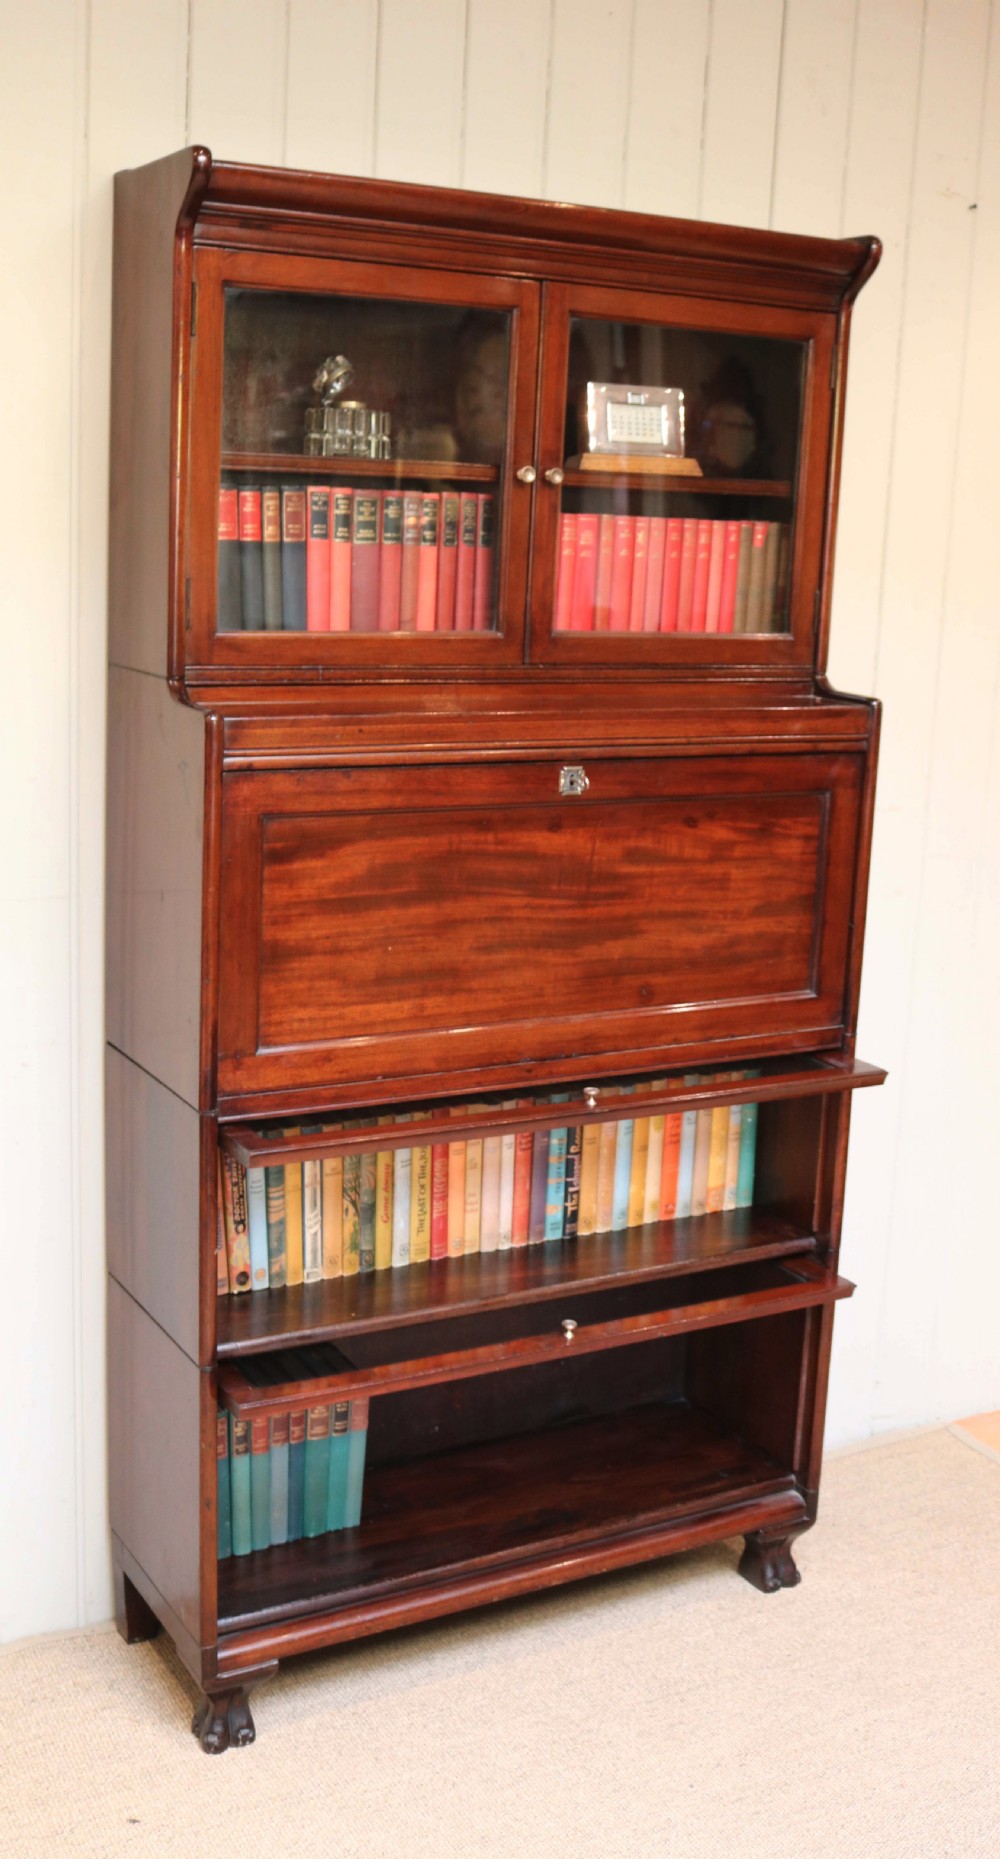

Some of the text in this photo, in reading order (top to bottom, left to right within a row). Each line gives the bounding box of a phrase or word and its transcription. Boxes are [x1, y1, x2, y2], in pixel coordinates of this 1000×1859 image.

[417, 1164, 427, 1183] THE
[418, 1182, 426, 1195] OF
[232, 1186, 241, 1221] DOCTOR
[381, 1195, 390, 1224] Gone
[417, 1195, 427, 1217] LAST
[564, 1193, 578, 1218] The
[416, 1218, 425, 1236] THE
